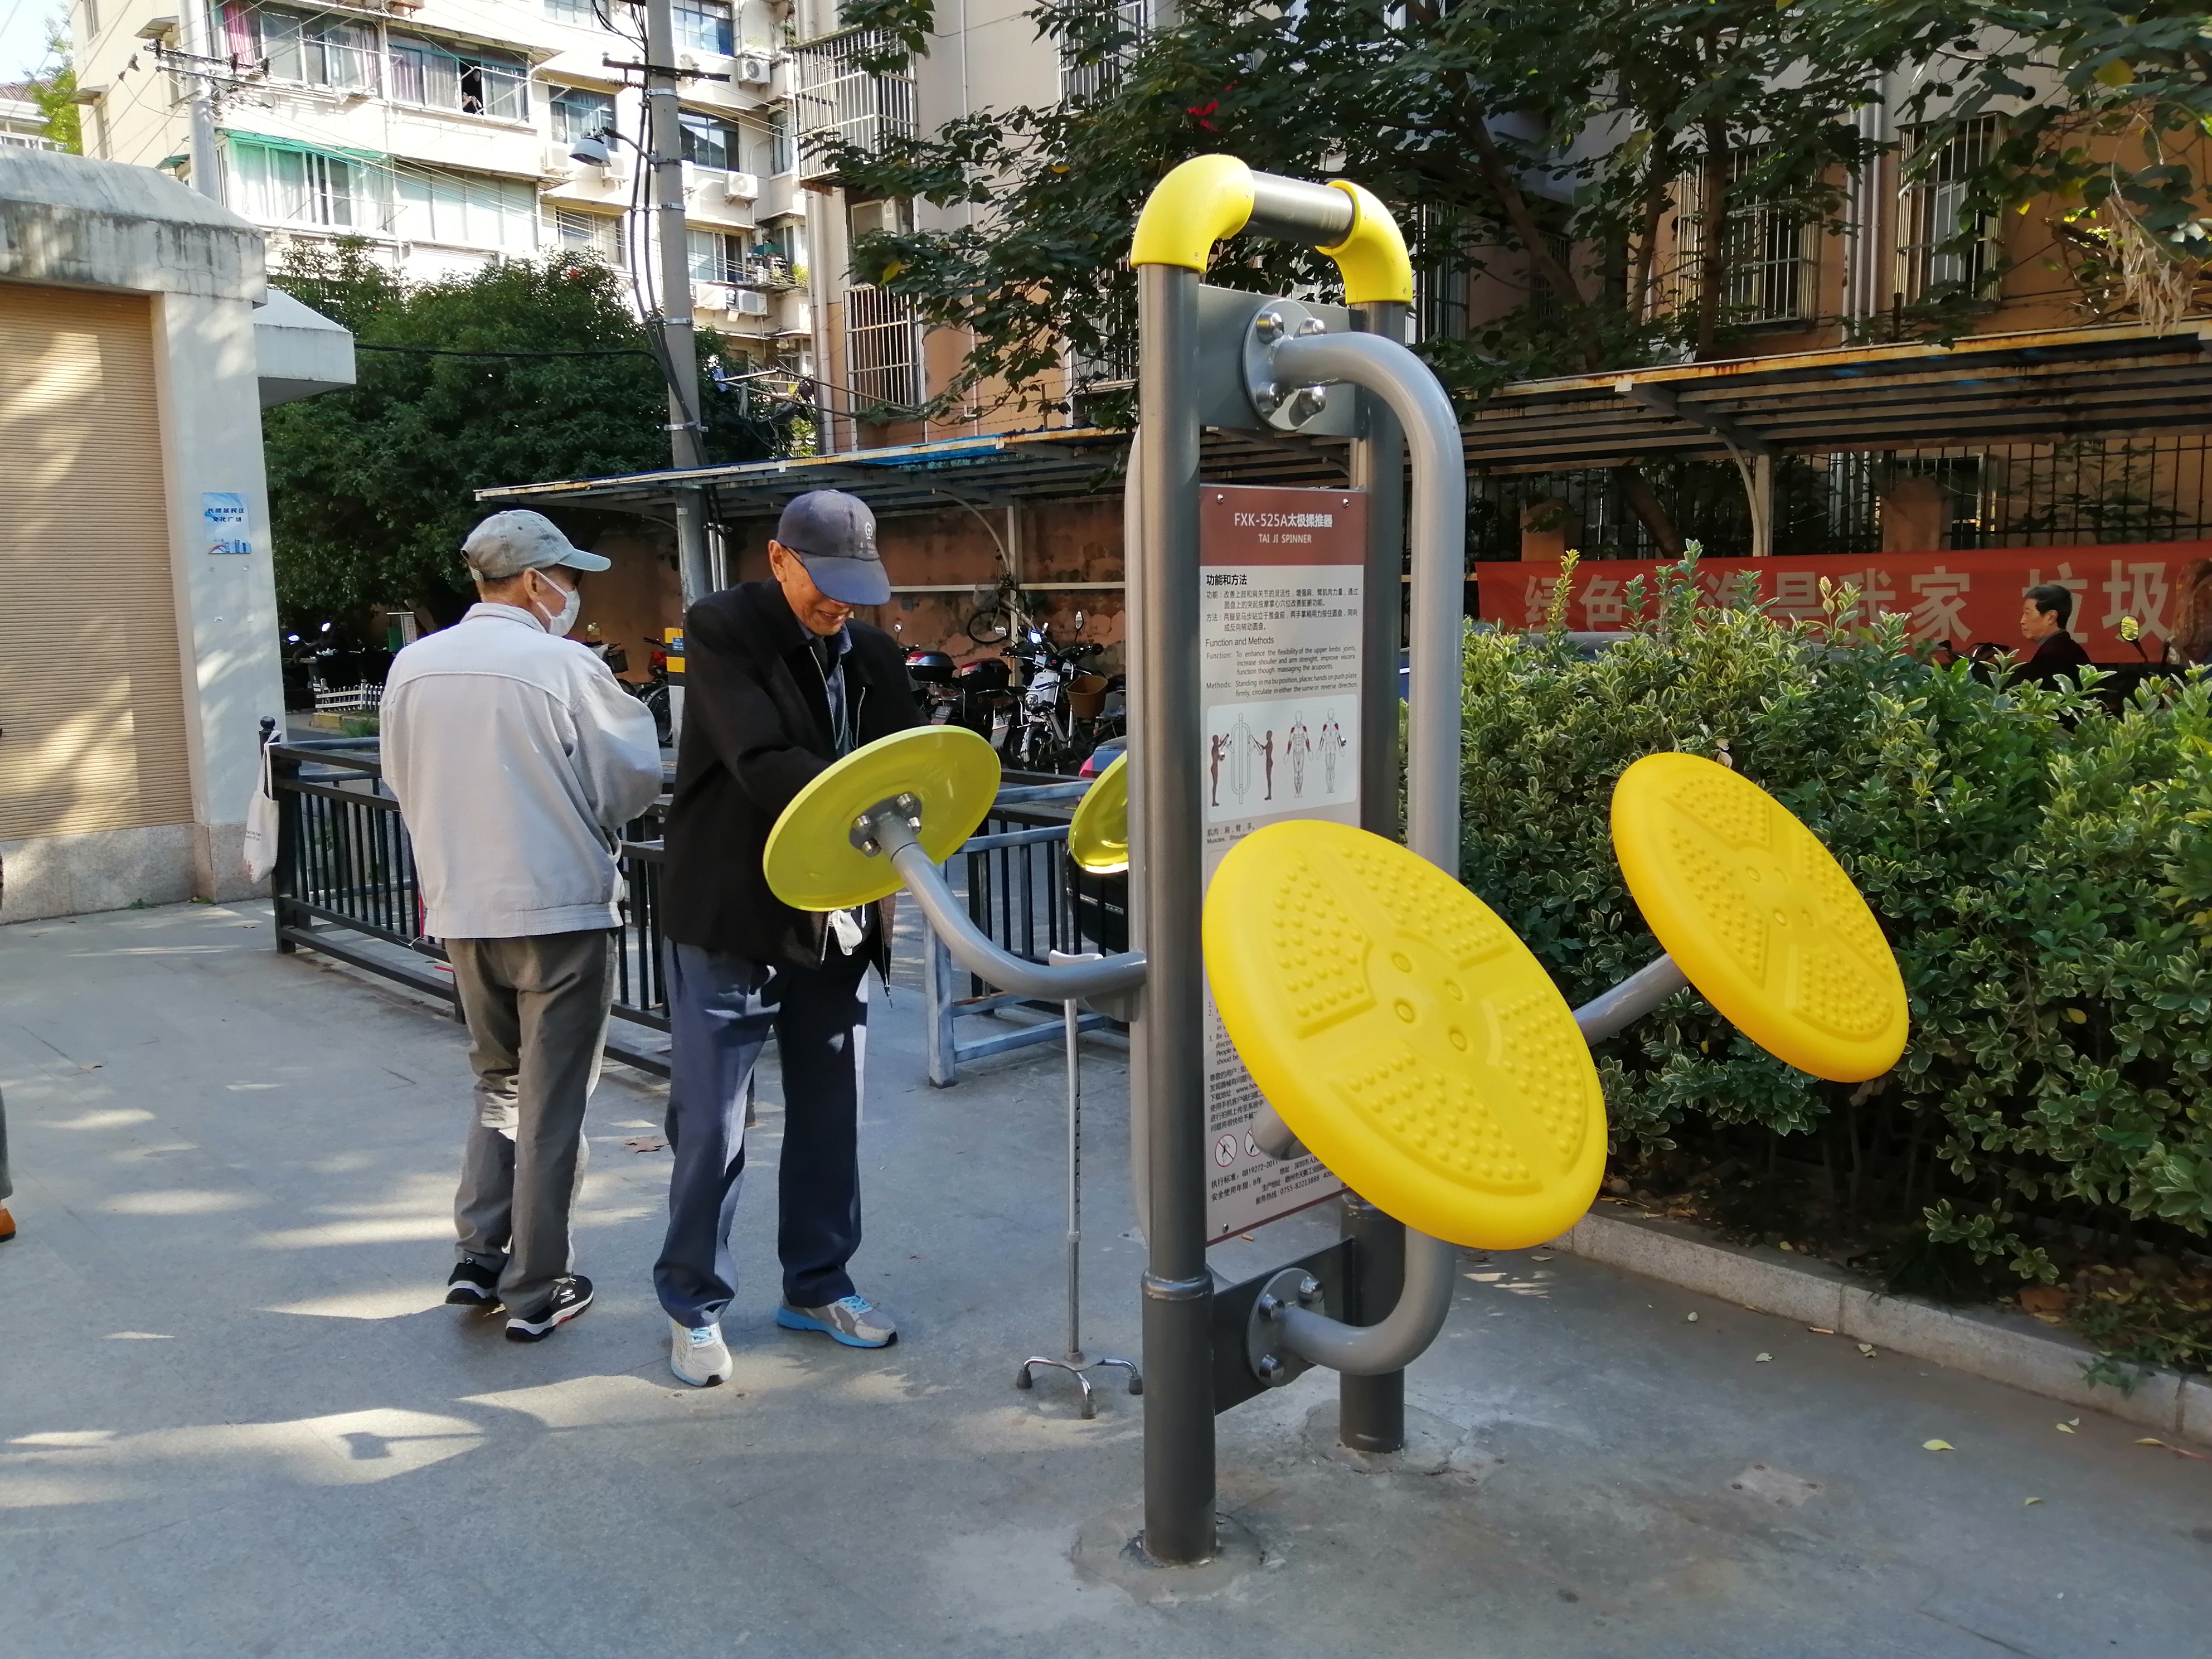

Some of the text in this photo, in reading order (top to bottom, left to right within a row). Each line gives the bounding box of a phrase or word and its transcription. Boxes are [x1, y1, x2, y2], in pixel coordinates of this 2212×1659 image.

[1234, 513, 1333, 528] FXK-525A太极揉推器
[1258, 533, 1312, 544] TAI JI SPINNER
[1206, 574, 1247, 586] 功能和方法
[1206, 636, 1274, 647] Function and Methods
[1278, 648, 1298, 656] flexibility
[1235, 679, 1257, 687] Standing
[1334, 672, 1345, 681] push
[1216, 1047, 1231, 1057] People
